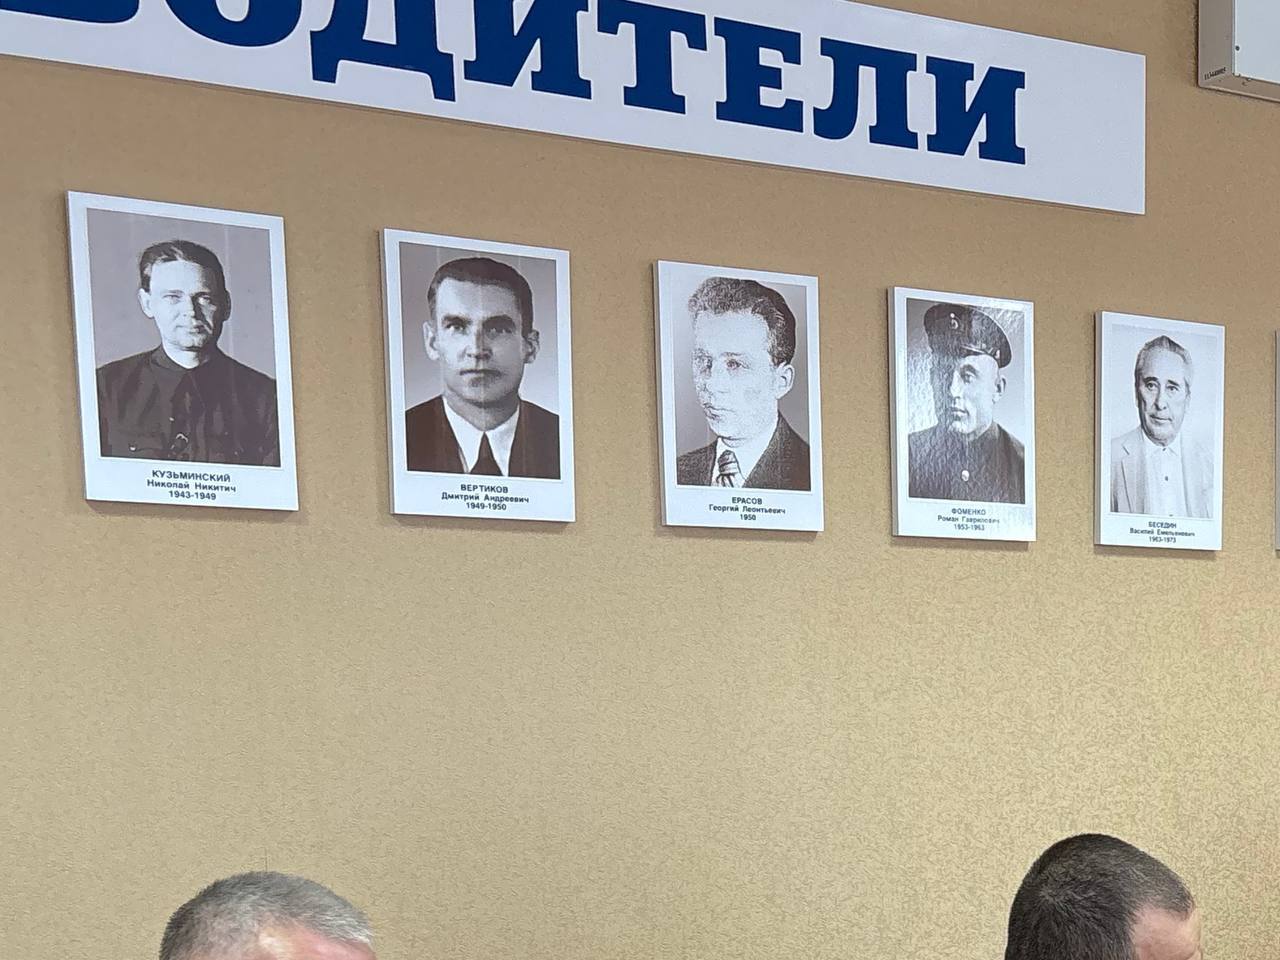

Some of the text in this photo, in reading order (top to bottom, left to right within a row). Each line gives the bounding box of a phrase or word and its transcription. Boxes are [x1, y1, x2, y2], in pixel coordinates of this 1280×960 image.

[0, 0, 1026, 164] ДИТЕЛИ
[152, 470, 231, 482] КУЗЬМИНСКИЙ
[147, 479, 236, 492] Николай Никитич
[460, 484, 509, 494] ВЕРТИКОВ
[169, 490, 217, 500] 1943-1949
[441, 492, 530, 503] Дмитрий Андреевич
[731, 497, 763, 505] ЕРАСОВ
[466, 502, 507, 511] 1949-1950
[709, 504, 786, 514] Георгий Леонтьевич
